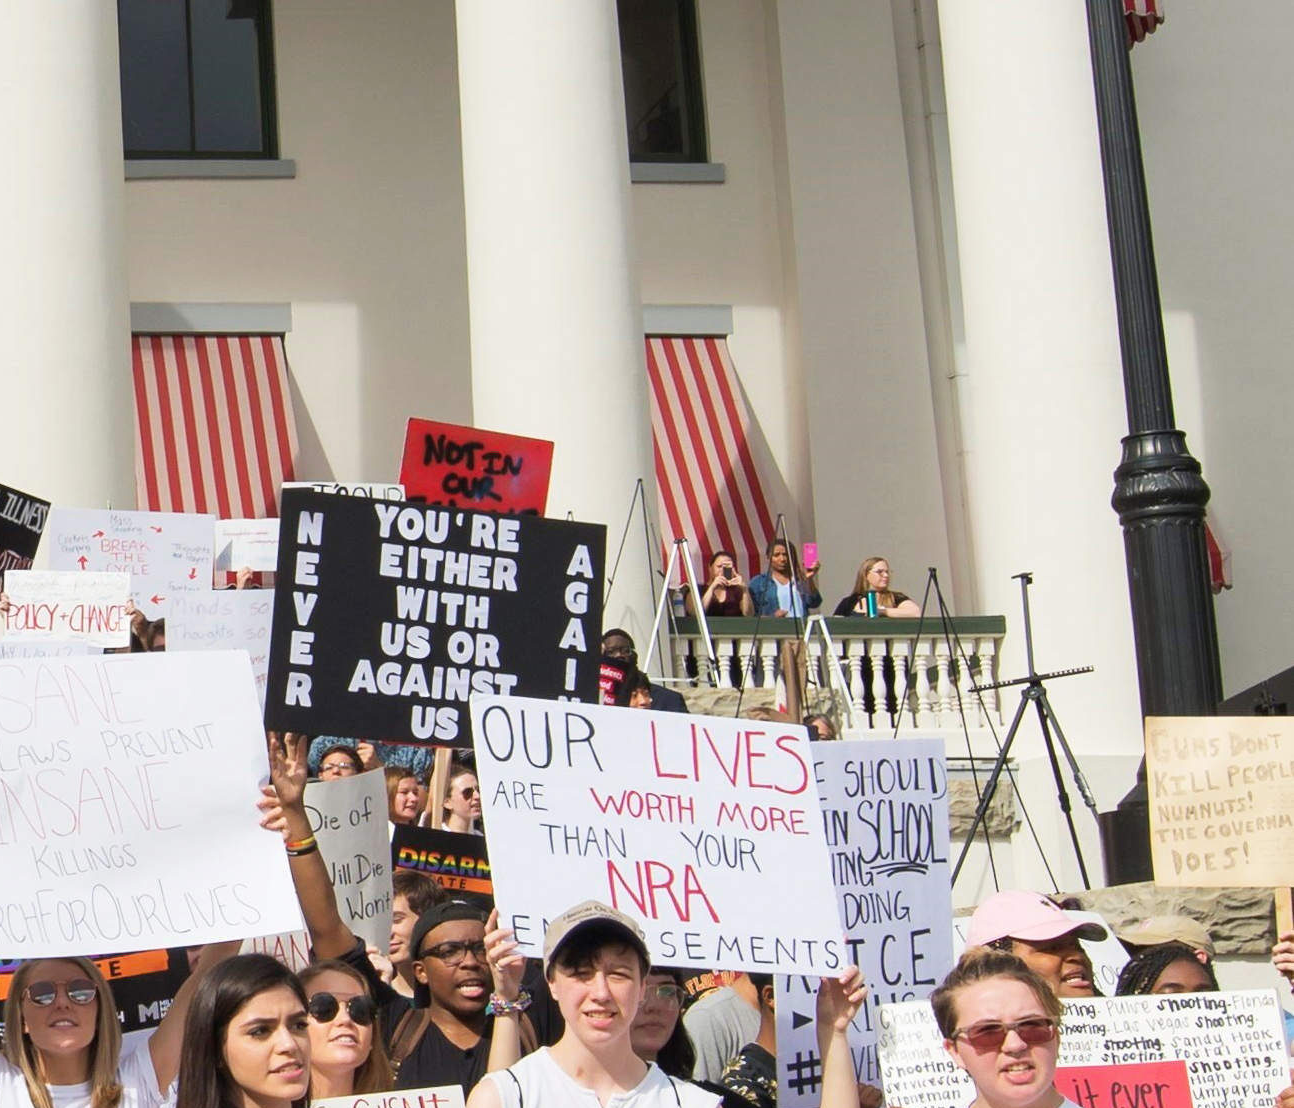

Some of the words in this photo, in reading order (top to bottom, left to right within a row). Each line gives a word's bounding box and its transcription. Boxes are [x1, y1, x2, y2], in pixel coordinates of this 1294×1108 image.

[424, 431, 479, 467] NOT
[482, 452, 523, 477] IN
[442, 472, 502, 502] OUR
[100, 539, 150, 553] BREAK
[374, 503, 521, 553] YOU'RE
[111, 553, 145, 563] THE
[379, 542, 518, 592] EITHER
[5, 604, 60, 631] POLICY
[284, 510, 324, 707] NEVER
[396, 585, 490, 630] WITH
[380, 622, 431, 660] US
[448, 631, 501, 668] OR
[347, 659, 518, 702] AGAINST
[101, 722, 214, 762] PREVENT
[411, 705, 460, 740] US
[482, 704, 604, 772] OUR
[651, 719, 809, 795] LIVES
[843, 756, 948, 800] SHOULD
[1154, 769, 1220, 799] KILL
[492, 780, 549, 812] ARE
[589, 787, 695, 825] WORTH
[716, 801, 810, 835] MORE
[540, 822, 628, 858] THAN
[680, 829, 762, 873] YOUR
[857, 799, 948, 865] SCHOOL
[1155, 826, 1197, 844] THE
[33, 843, 138, 880] KILLINGS
[354, 854, 384, 885] Die
[1171, 840, 1250, 876] DOES!
[606, 858, 721, 924] NRA
[842, 890, 911, 931] DOING
